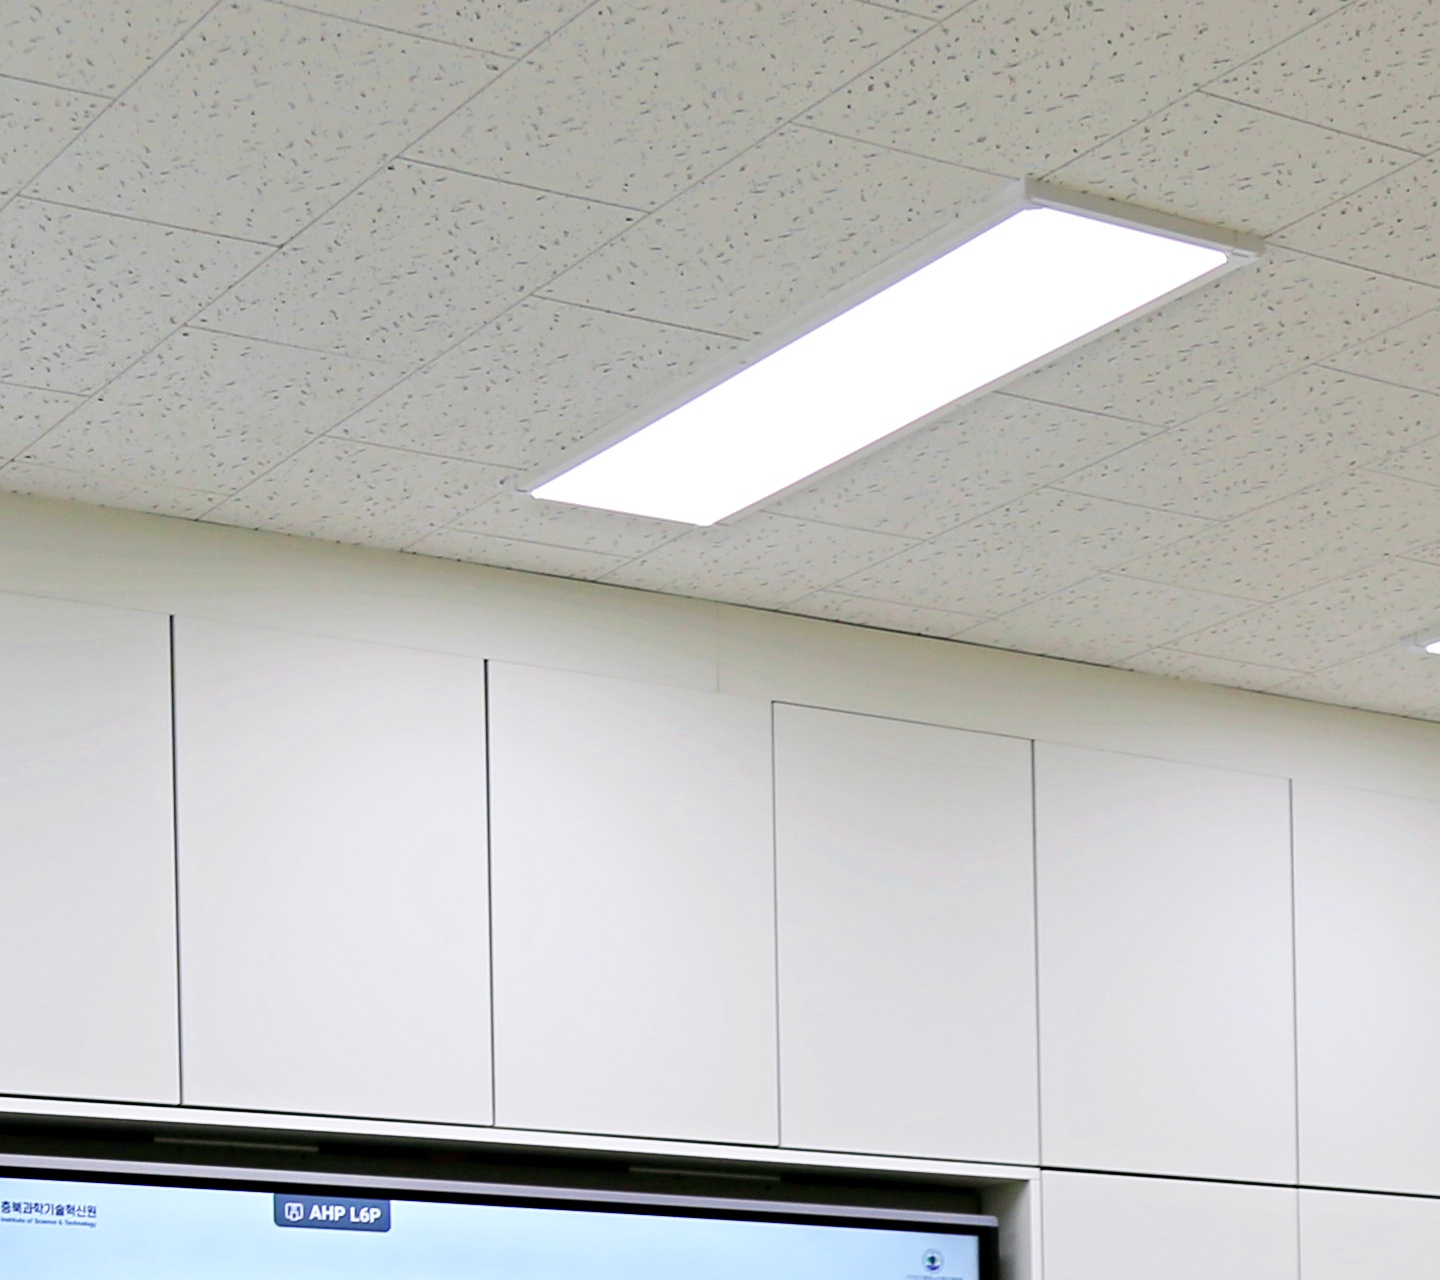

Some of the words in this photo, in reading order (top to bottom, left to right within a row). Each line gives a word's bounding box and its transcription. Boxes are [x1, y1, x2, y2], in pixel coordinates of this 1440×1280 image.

[1, 1201, 97, 1218] 충북과학기술혁신원
[309, 1205, 346, 1222] AHP
[350, 1206, 383, 1224] L6P
